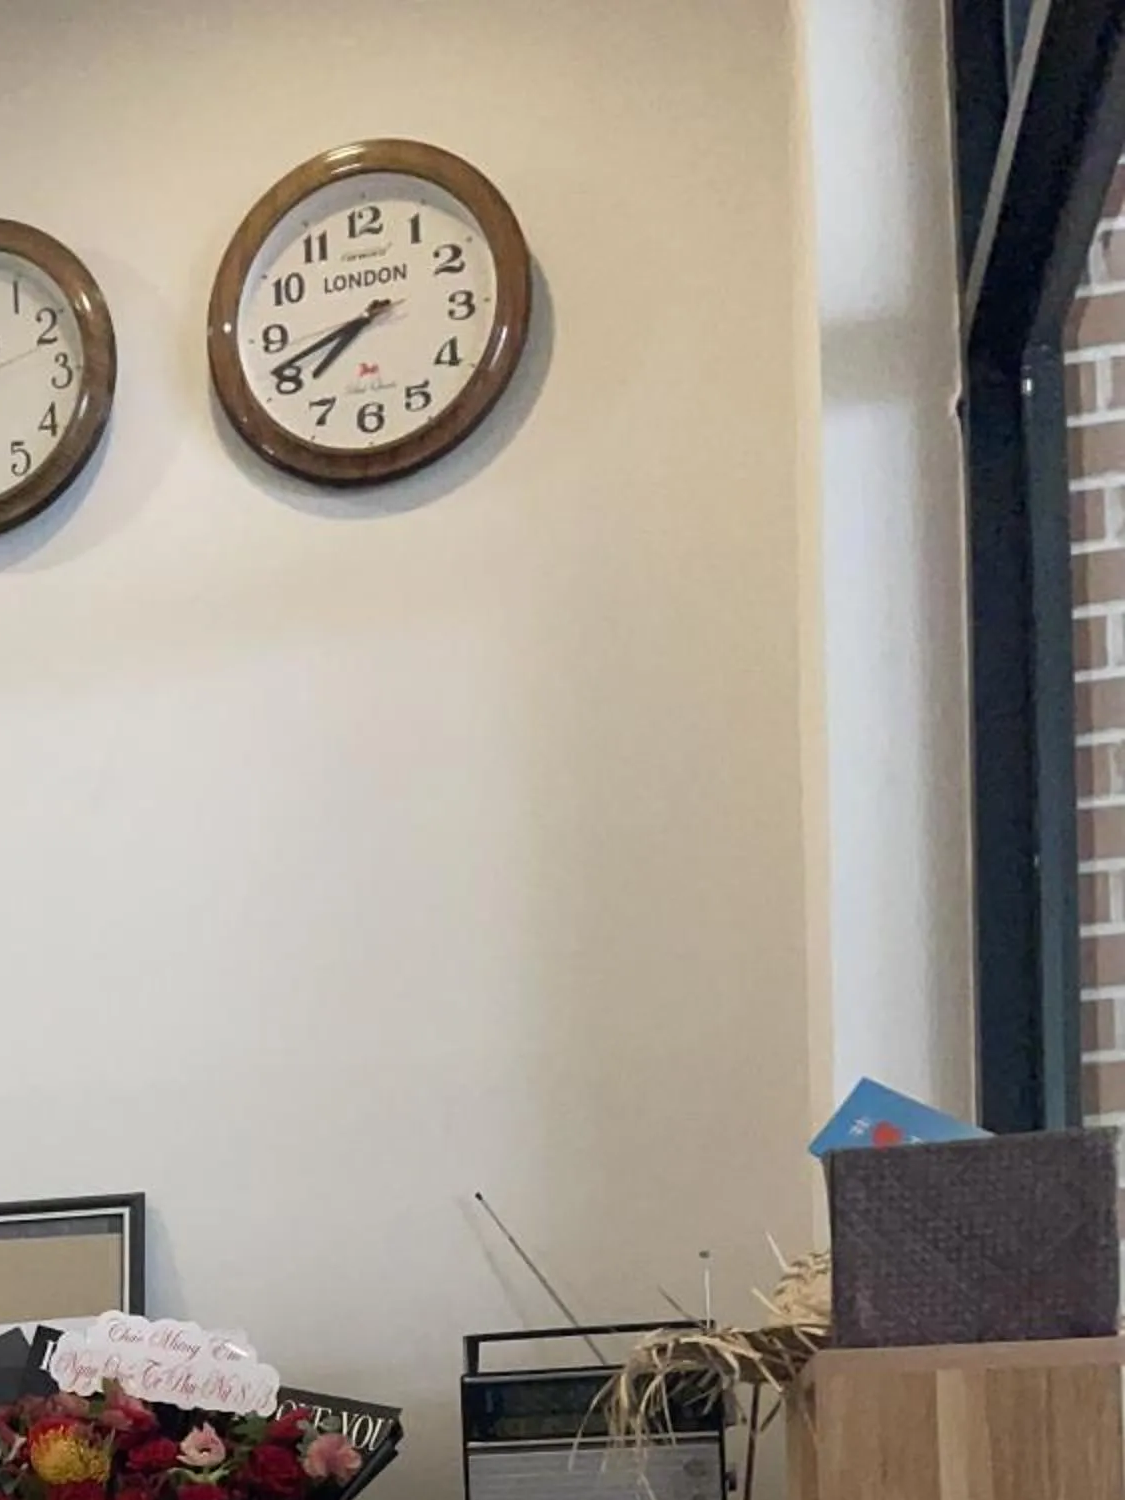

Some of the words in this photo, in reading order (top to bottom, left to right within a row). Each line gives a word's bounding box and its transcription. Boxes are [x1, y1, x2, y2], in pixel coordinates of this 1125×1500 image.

[347, 206, 383, 238] 12
[408, 213, 422, 244] 1
[303, 232, 327, 264] 11
[433, 244, 466, 276] 2
[272, 272, 305, 306] 10
[324, 262, 408, 295] LONDON
[13, 280, 19, 314] 1
[448, 290, 475, 320] 3
[35, 307, 58, 345] 2
[262, 324, 289, 353] 9
[434, 337, 462, 366] 4
[51, 352, 73, 389] 3
[275, 364, 303, 394] 8
[309, 397, 336, 426] 7
[405, 380, 431, 412] 5
[38, 402, 57, 437] 4
[356, 402, 384, 433] 6
[11, 441, 31, 476] 5
